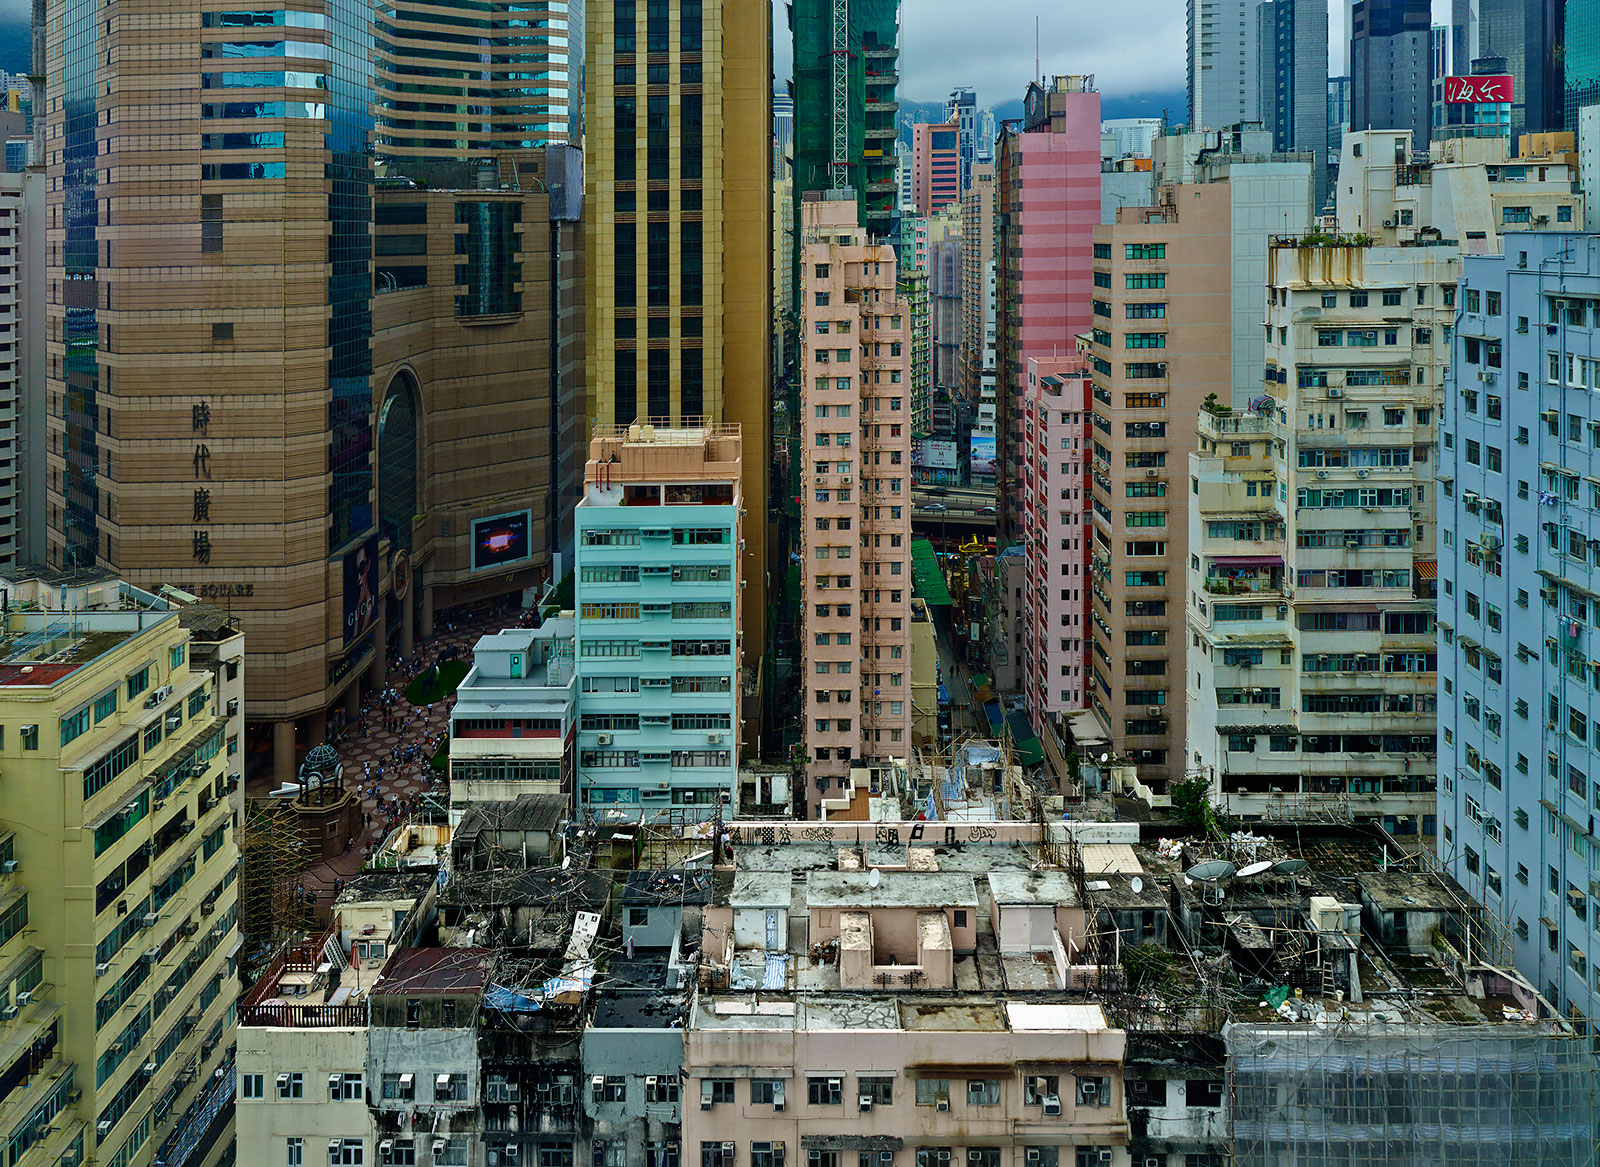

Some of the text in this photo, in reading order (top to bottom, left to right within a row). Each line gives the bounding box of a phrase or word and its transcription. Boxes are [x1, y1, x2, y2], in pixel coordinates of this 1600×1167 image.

[192, 400, 213, 565] 時代廣場
[200, 583, 254, 598] SQUARE
[347, 594, 375, 626] GUCCI
